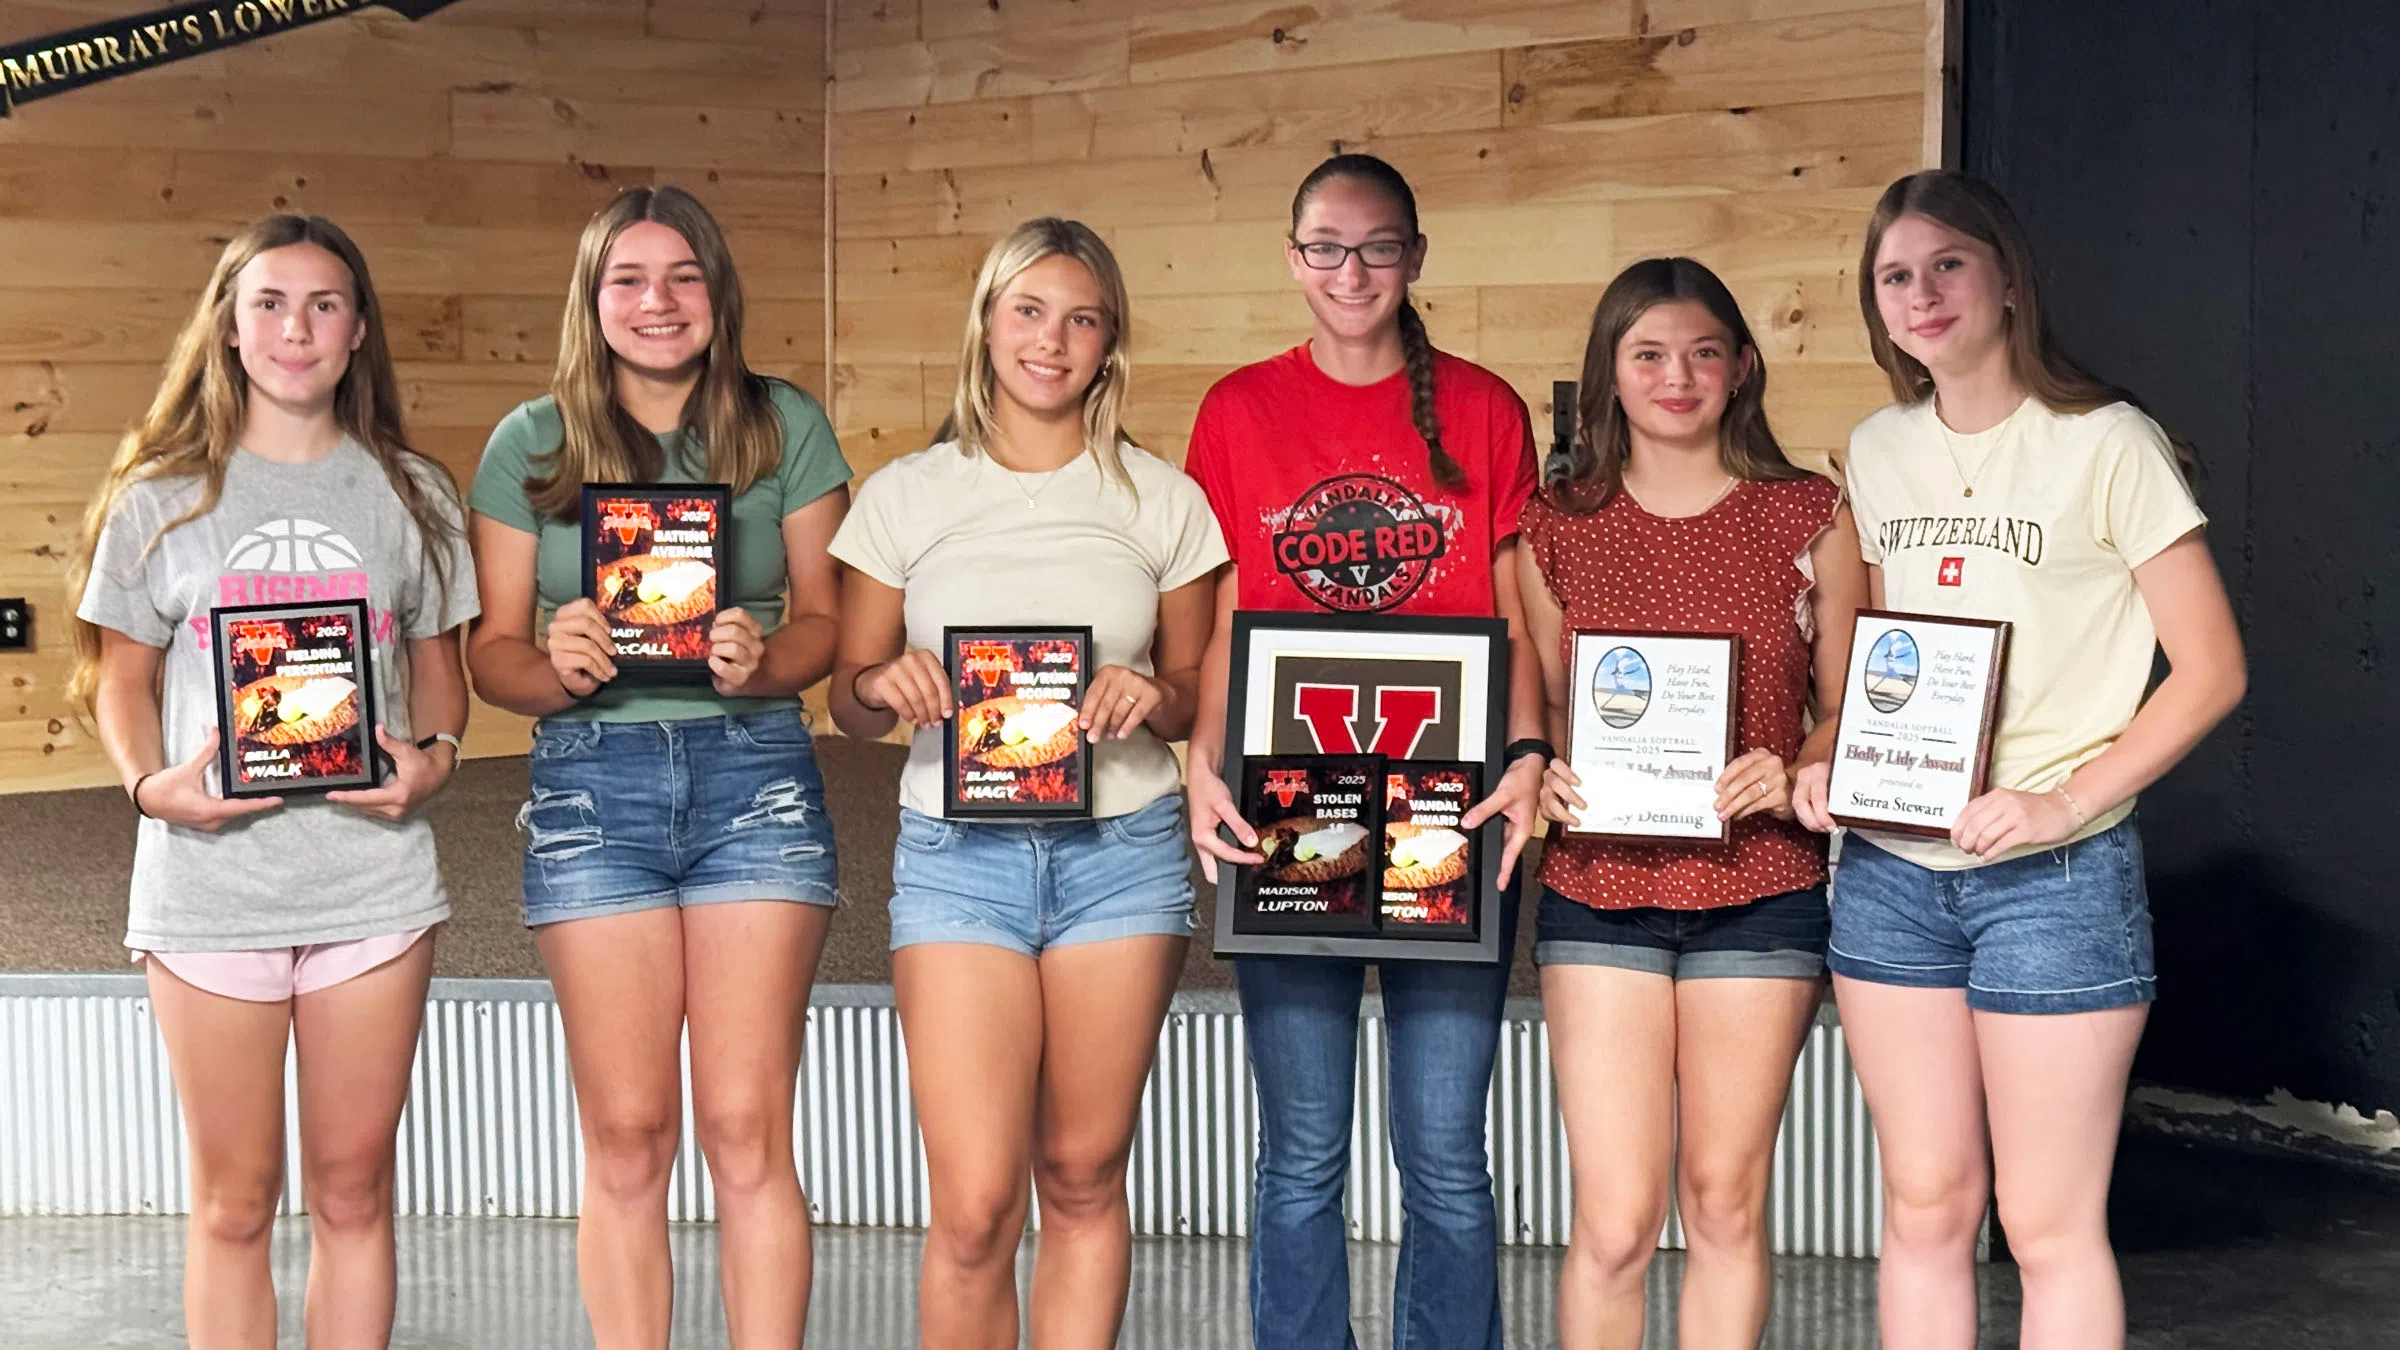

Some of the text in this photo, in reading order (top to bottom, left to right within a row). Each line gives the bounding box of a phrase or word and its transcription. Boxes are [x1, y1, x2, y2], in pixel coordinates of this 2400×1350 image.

[3, 15, 203, 90] MURRAY'S
[681, 511, 710, 522] 2025
[654, 530, 709, 543] BATTING
[1879, 516, 2043, 566] SWITZERLAND
[651, 545, 713, 559] AVERAGE
[1278, 523, 1439, 569] CODE RED
[1349, 565, 1371, 585] V
[1317, 566, 1411, 604] VANDALS
[316, 626, 347, 637] 2025
[286, 648, 341, 662] FIELDING
[1042, 652, 1072, 663] 2025
[276, 662, 353, 678] PERCENTAGE
[1016, 687, 1071, 700] SCORED
[1294, 682, 1441, 760] V
[1867, 718, 1952, 736] VANDALIA SOFTBALL
[1601, 735, 1696, 746] VANDALIA SOFTBALL
[1896, 731, 1920, 743] 2025
[245, 750, 290, 762] BELLA
[1635, 745, 1661, 755] 2025
[1844, 744, 1966, 773] Holly Lidy Award
[247, 763, 303, 777] WALK
[1662, 764, 1714, 781] Award
[1337, 775, 1367, 785] 2025
[1268, 769, 1308, 808] V
[1434, 782, 1464, 792] 2025
[1313, 793, 1362, 805] STOLEN
[1408, 799, 1462, 812] VANDAL
[1850, 791, 1944, 817] Sierra Stewart
[1316, 808, 1358, 819] BASES
[1410, 814, 1459, 826] AWARD
[1638, 811, 1705, 829] Denning
[1258, 887, 1319, 896] MADISON
[1257, 901, 1329, 912] LUPTON
[1381, 906, 1429, 918] PTON
